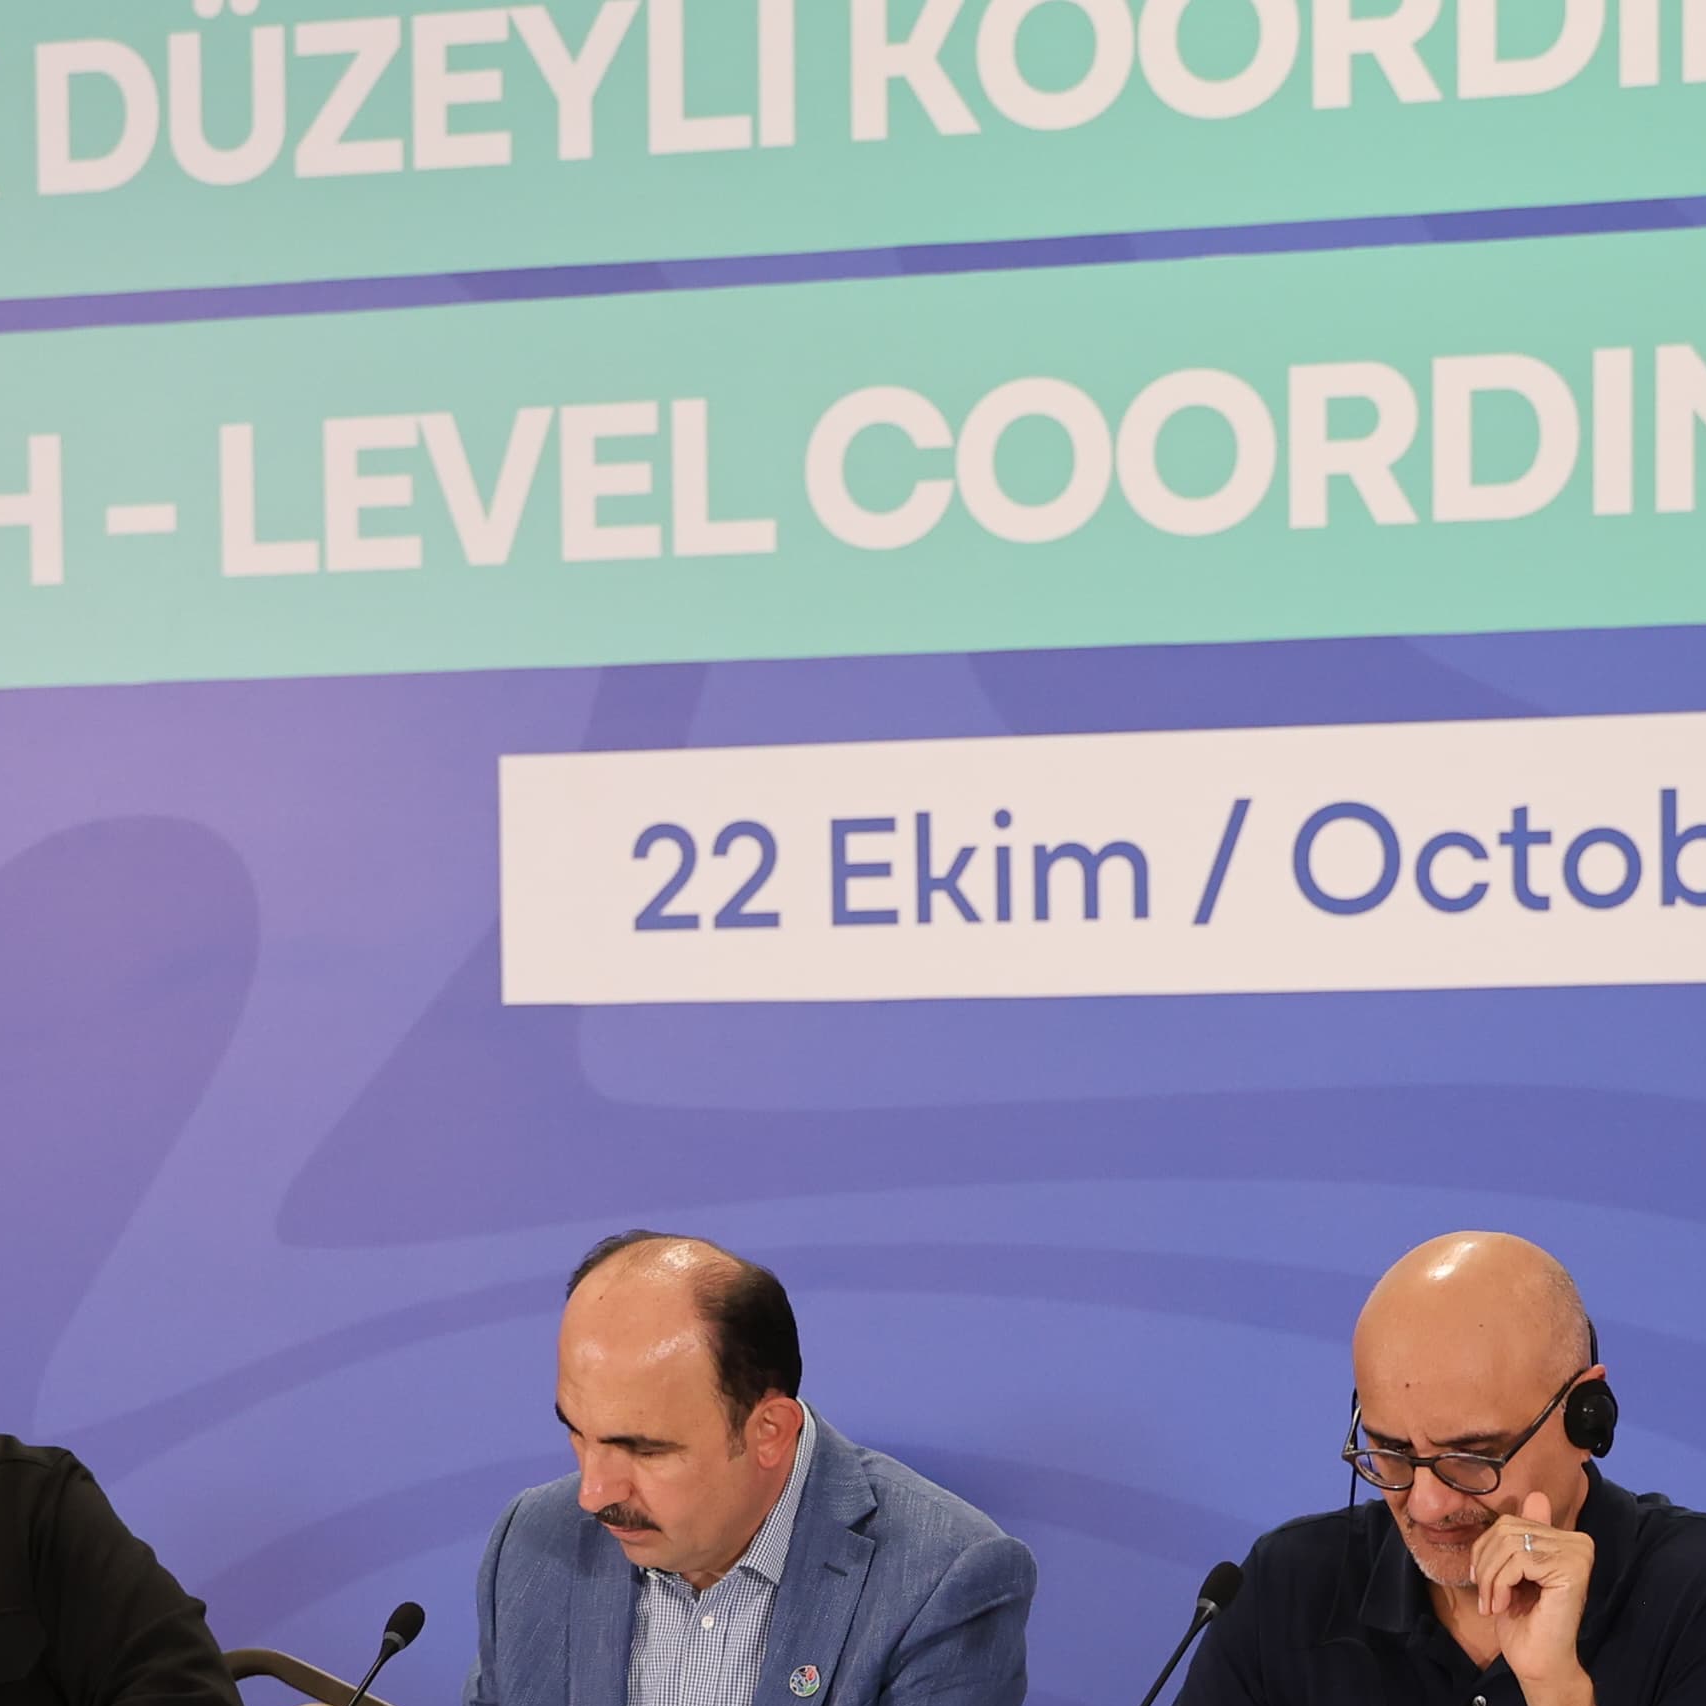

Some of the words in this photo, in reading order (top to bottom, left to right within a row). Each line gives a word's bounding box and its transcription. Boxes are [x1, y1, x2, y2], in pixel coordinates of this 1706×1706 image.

[220, 399, 777, 576] LEVEL
[631, 819, 781, 932] 22
[829, 807, 1151, 928] Ekim
[1192, 797, 1253, 927] /
